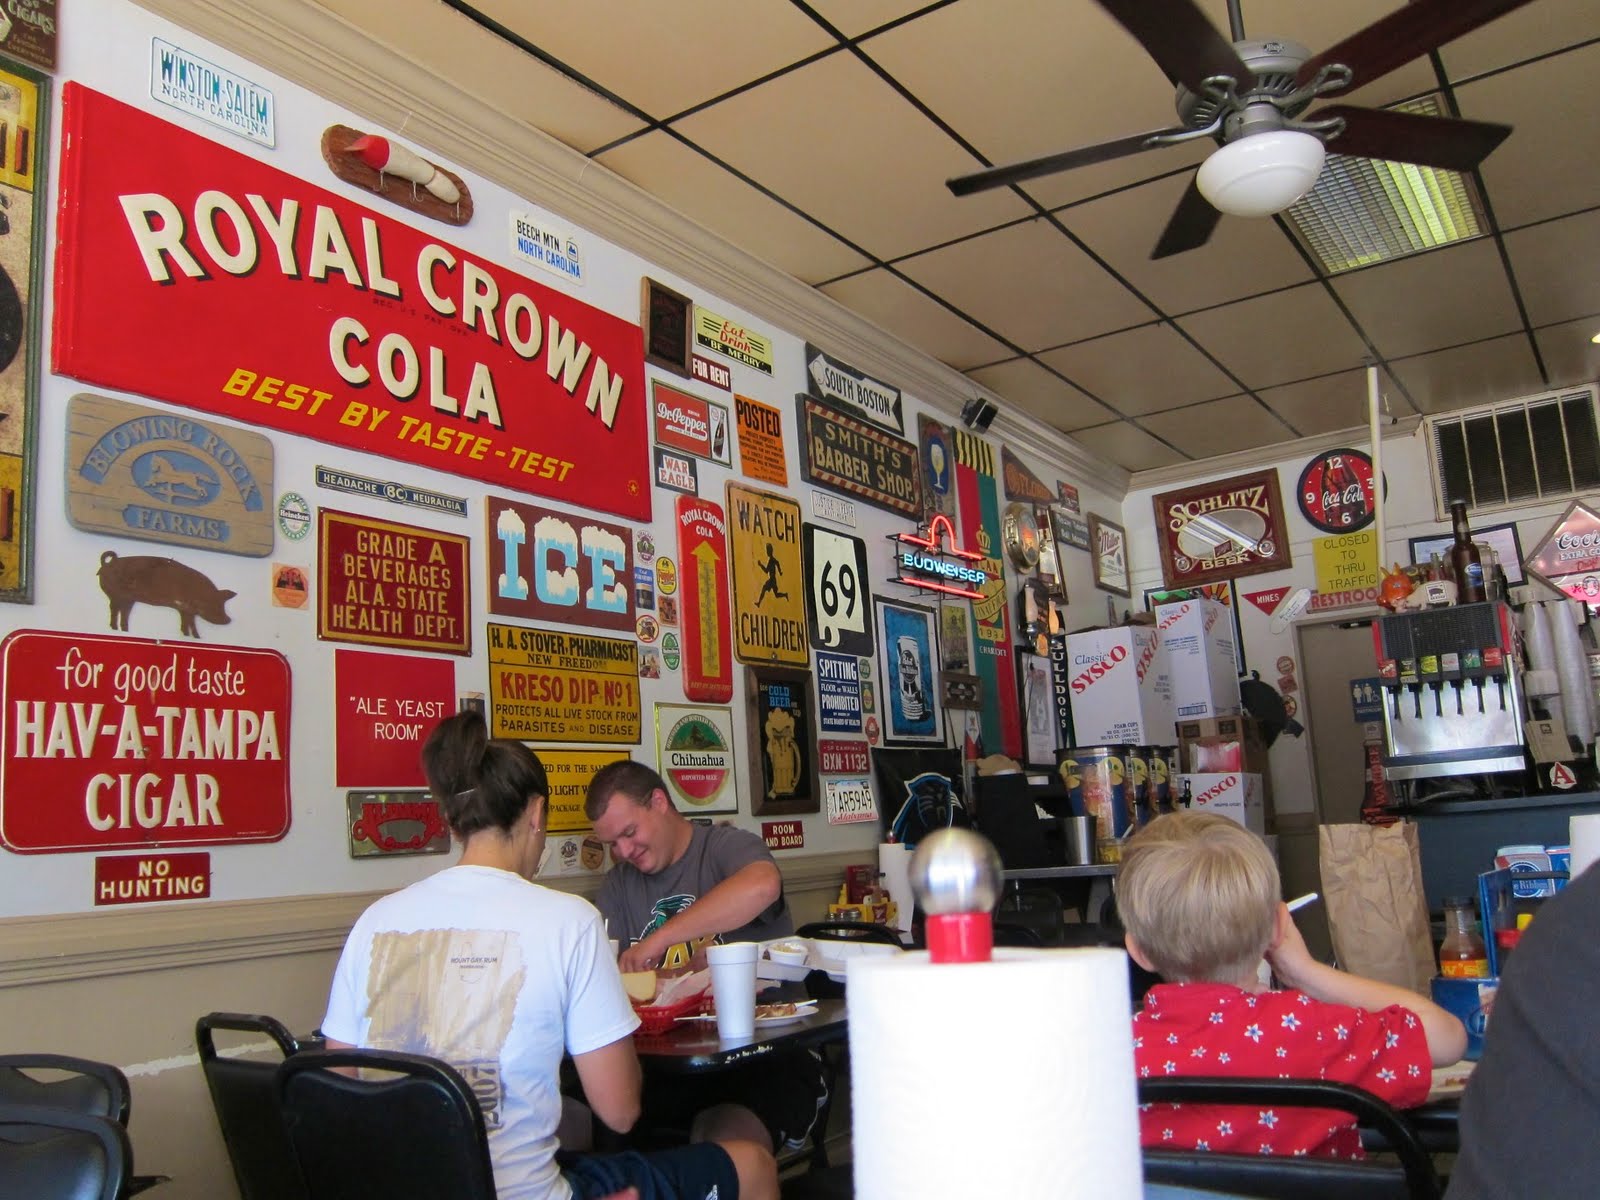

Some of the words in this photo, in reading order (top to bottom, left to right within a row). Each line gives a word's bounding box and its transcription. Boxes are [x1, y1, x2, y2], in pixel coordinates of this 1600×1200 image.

[160, 49, 268, 125] WINSTON-SALEM
[161, 83, 206, 112] NORTH
[209, 103, 268, 138] CAROLINA
[516, 219, 541, 243] BEECH
[543, 227, 562, 255] MTN.
[517, 237, 543, 260] NORTH
[546, 245, 582, 280] CAROLINA
[118, 190, 400, 298] ROYAL
[416, 243, 624, 430] CROWN
[719, 330, 752, 354] Drink
[722, 321, 746, 340] Eat
[329, 317, 503, 428] COLA
[692, 358, 708, 379] FOR
[710, 366, 729, 388] RENT
[222, 368, 333, 416] BEST
[340, 401, 390, 432] BY
[825, 367, 854, 400] SOUTH
[857, 385, 891, 418] BOSTON
[736, 399, 781, 438] POSTED
[825, 422, 901, 468] SMITH'S
[87, 417, 194, 475] BLOWING
[203, 433, 257, 503] ROCK
[664, 456, 688, 475] WAR
[814, 435, 871, 485] BARBER
[1327, 456, 1343, 470] 12
[660, 468, 694, 490] EAGLE
[323, 473, 378, 494] HEADACHE
[412, 492, 462, 512] NEURALGIA
[1305, 492, 1316, 504] 9
[279, 510, 309, 521] Heineken
[736, 498, 796, 544] WATCH
[1169, 485, 1270, 533] SCHLITZ
[1341, 512, 1352, 524] 6
[138, 510, 220, 541] FARMS
[680, 508, 702, 526] ROYAL
[702, 510, 726, 536] CROWN
[695, 524, 713, 538] COLA
[357, 530, 418, 562] GRADE
[428, 541, 447, 566] A
[1323, 533, 1370, 550] CLOSED
[497, 507, 629, 615] ICE
[1201, 553, 1251, 571] BEER
[1340, 549, 1357, 560] TO
[343, 553, 451, 590] BEVERAGES
[903, 552, 985, 585] BUDWEISER
[1335, 561, 1366, 575] THRU
[820, 559, 856, 619] 69
[1328, 574, 1377, 590] TRAFFIC
[345, 579, 391, 607] ALA.
[396, 586, 448, 614] STATE
[1256, 593, 1280, 604] MINES
[1310, 587, 1378, 609] RESTROO
[332, 603, 403, 634] HEALTH
[414, 613, 460, 640] DEPT.
[1158, 603, 1190, 630] SYSCO
[491, 627, 503, 648] H.
[506, 629, 518, 650] A.
[569, 637, 636, 663] PHARMACIST
[740, 612, 805, 653] CHILDREN
[527, 653, 553, 666] NEW
[818, 658, 857, 681] SPITTING
[1070, 645, 1127, 695] SYSCO
[1074, 651, 1108, 666] Classic
[56, 646, 104, 690] for
[113, 653, 178, 703] good
[187, 657, 247, 697] taste
[1050, 641, 1067, 729] BULLDOGS
[500, 671, 564, 703] KRESO
[568, 676, 599, 705] DIP
[625, 682, 633, 708] 1
[768, 685, 790, 697] COLD
[820, 683, 836, 693] FLOOR
[395, 699, 445, 719] YEAST
[495, 703, 542, 718] PROTECTS
[544, 706, 561, 719] ALL
[563, 708, 582, 720] LIVE
[585, 709, 613, 721] STOCK
[615, 711, 639, 722] FROM
[769, 696, 791, 708] BEER
[821, 693, 860, 712] PROHIBITED
[14, 699, 282, 762] HAV-A-TAMPA
[501, 719, 566, 733] PARASITES
[568, 724, 585, 732] AND
[589, 724, 634, 736] DISEASE
[557, 764, 571, 773] FOR
[574, 764, 588, 773] THE
[671, 752, 725, 767] Chihuahua
[1552, 764, 1575, 785] A
[85, 772, 225, 832] CIGAR
[554, 785, 580, 796] LIGHT
[832, 789, 873, 814] 1AR5949
[1196, 775, 1237, 806] SYSCO
[550, 804, 581, 813] PACKAGE
[765, 836, 780, 848] AND
[781, 835, 803, 847] BOARD
[772, 823, 795, 835] ROOM
[138, 859, 171, 878] NO
[99, 876, 205, 900] HUNTING
